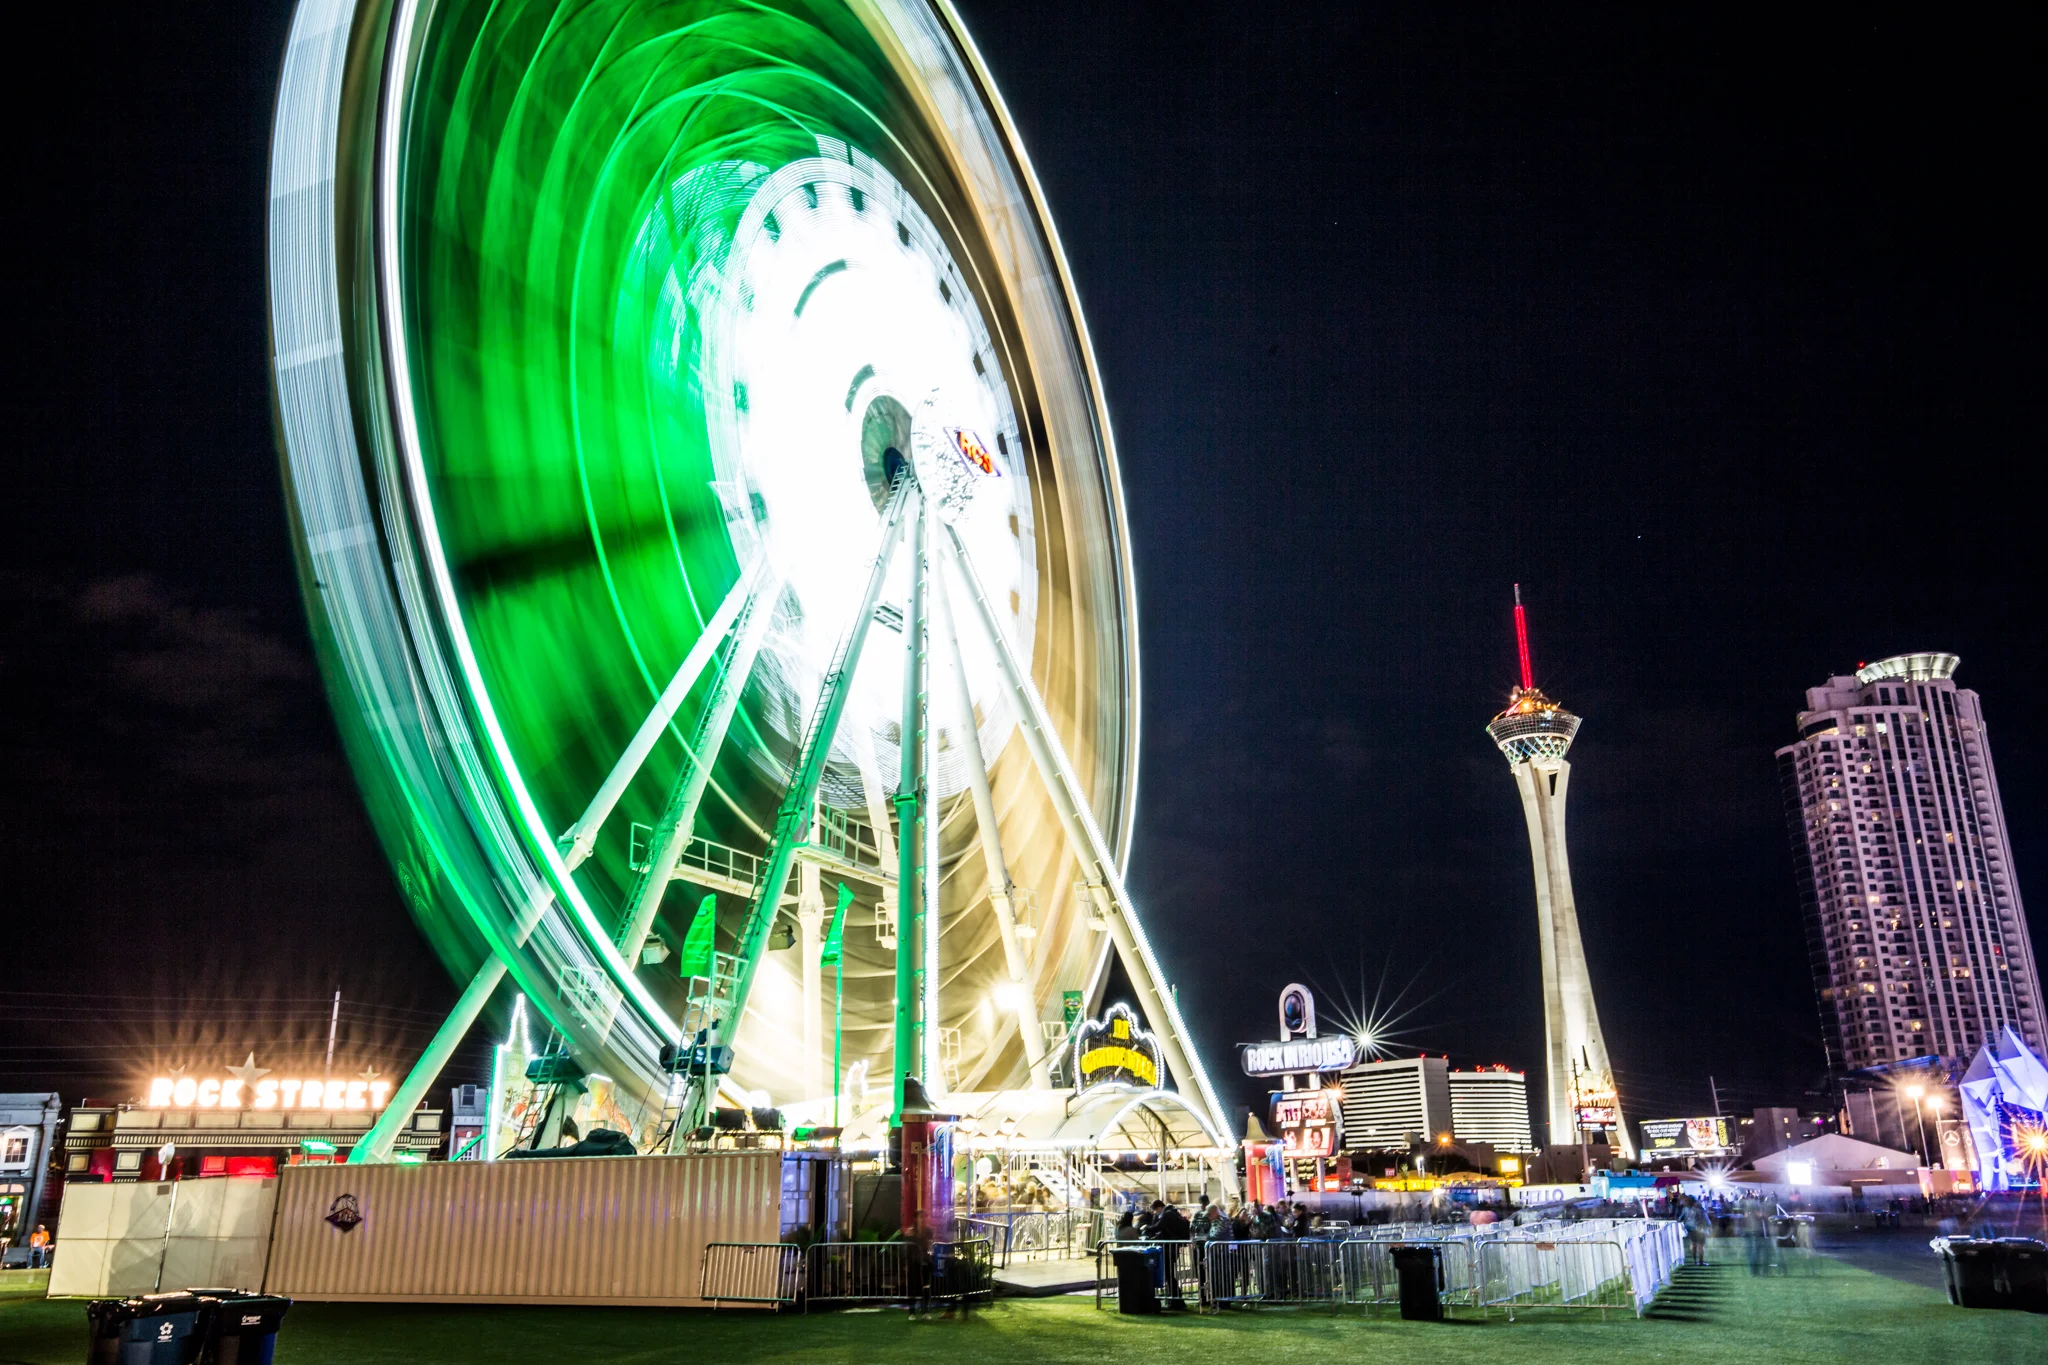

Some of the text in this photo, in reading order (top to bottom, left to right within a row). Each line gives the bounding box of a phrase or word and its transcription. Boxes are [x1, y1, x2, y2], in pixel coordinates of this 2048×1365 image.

[1247, 1039, 1352, 1072] ROCK IN RIO USA
[149, 1078, 391, 1109] ROCK STREET
[1519, 1189, 1564, 1206] HELLO
